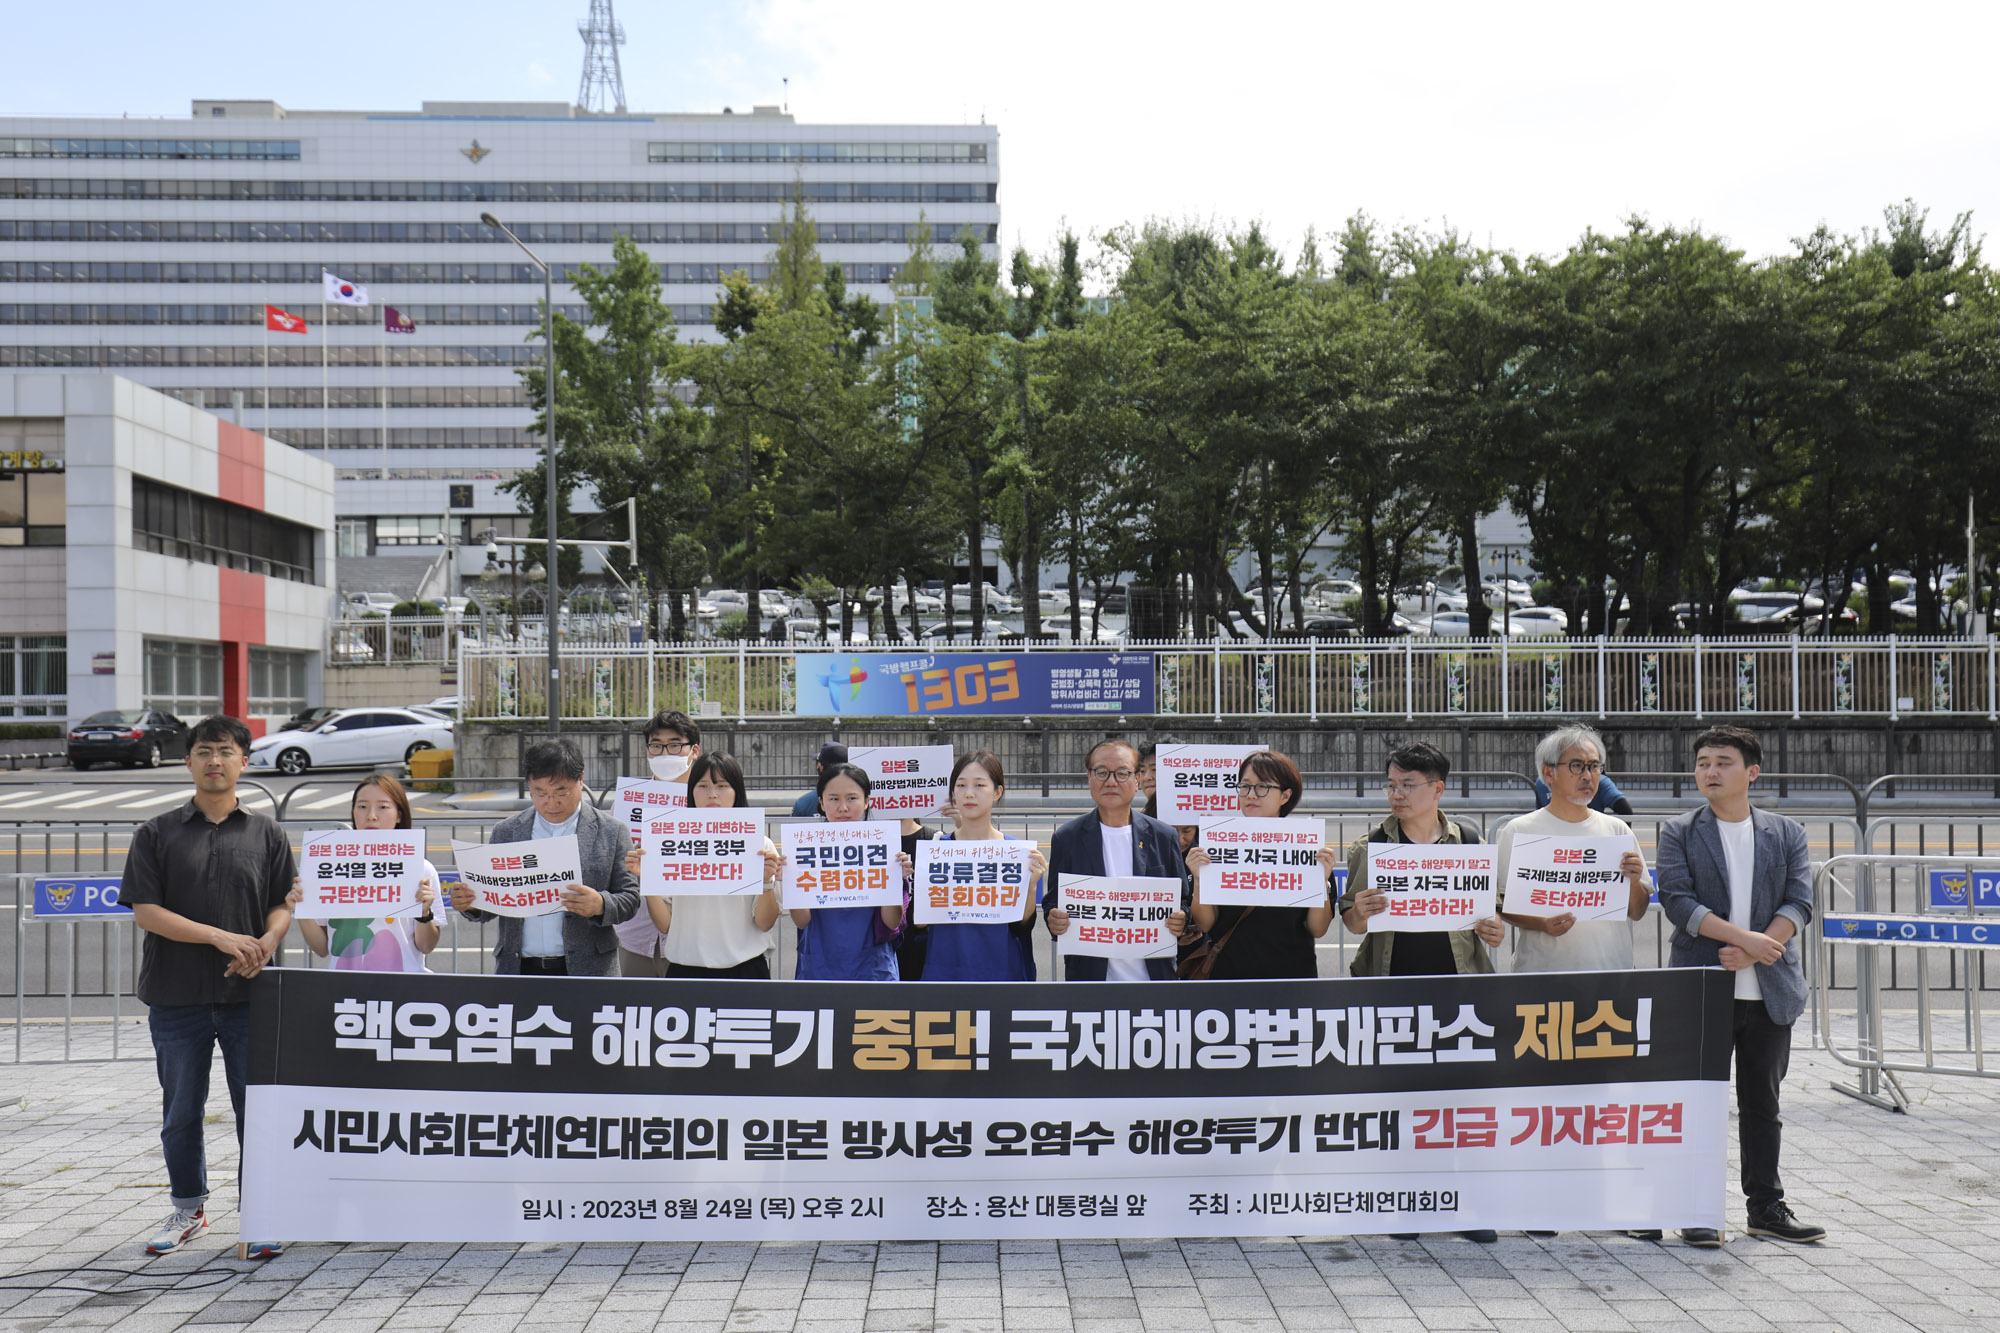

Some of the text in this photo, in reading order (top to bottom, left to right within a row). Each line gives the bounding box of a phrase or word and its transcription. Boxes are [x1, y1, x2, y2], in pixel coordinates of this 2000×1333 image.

[1102, 669, 1118, 678] 상담
[900, 659, 1020, 713] 1303
[1104, 679, 1140, 688] 신고/상담
[1051, 690, 1140, 699] 방위사업비리 신고/상담
[880, 759, 920, 774] 일본을
[1163, 758, 1241, 768] 핵오염수 해양투기
[1173, 772, 1237, 789] 윤석열 정
[623, 790, 645, 803] 일본
[647, 792, 671, 806] 입장
[870, 794, 934, 810] 제소하라!
[651, 820, 756, 835] 일본 입장 대변하는
[793, 830, 884, 843] 방류결정 반대하는
[1206, 831, 1319, 845] 핵오염수 해양투기 말고
[308, 843, 416, 857] 일본 입장 대변하는
[660, 839, 746, 857] 윤석열 정부
[795, 844, 888, 868] 국민의견
[930, 846, 1021, 859] 전세계 위협하는
[1207, 848, 1317, 866] 일본 자국 내에
[1553, 848, 1598, 864] 일본은
[317, 861, 404, 879] 윤석열 정부
[490, 854, 539, 871] 일본을
[662, 862, 743, 881] 규탄한다!
[1375, 858, 1491, 870] 핵오염수 해양투기 말고
[465, 871, 574, 887] 국제해양법재판소에
[796, 869, 889, 892] 수렴하라
[928, 862, 1022, 884] 방류결정
[1220, 871, 1303, 891] 보관하라!
[1516, 867, 1624, 884] 국제범죄 해양투기
[1375, 875, 1490, 892] 일본 자국 내에
[84, 886, 121, 907] PO
[318, 884, 401, 904] 규탄한다!
[484, 889, 559, 907] 제소하라!
[928, 886, 1020, 908] 철회하라
[1065, 887, 1175, 903] 핵오염수 해양투기 말고
[1530, 888, 1607, 908] 중단하라!
[1066, 904, 1173, 922] 일본 자국 내에
[1389, 898, 1474, 916] 보관하라!
[1078, 925, 1159, 945] 보관하라!
[1876, 922, 1988, 942] POLIC
[333, 998, 1653, 1071] 핵오염수 해양투기 중단! 국제해양법재판소 제소!
[293, 1102, 1683, 1161] 시민사회단체연대회의 일본 방사성 오염수 해양투기 반대 긴급 기자회견
[521, 1199, 563, 1221] 일시
[582, 1198, 657, 1220] 2023년
[664, 1198, 698, 1220] 8월
[705, 1198, 753, 1220] 24일
[760, 1196, 796, 1221] (목)
[802, 1196, 844, 1219] 오후
[850, 1196, 884, 1219] 2시
[926, 1196, 968, 1219] 장소
[986, 1195, 1030, 1218] 용산
[1035, 1194, 1119, 1218] 대통령실
[1126, 1194, 1148, 1217] 앞
[1188, 1192, 1229, 1216] 주최
[1248, 1190, 1459, 1215] 시민사회단체연대회의
